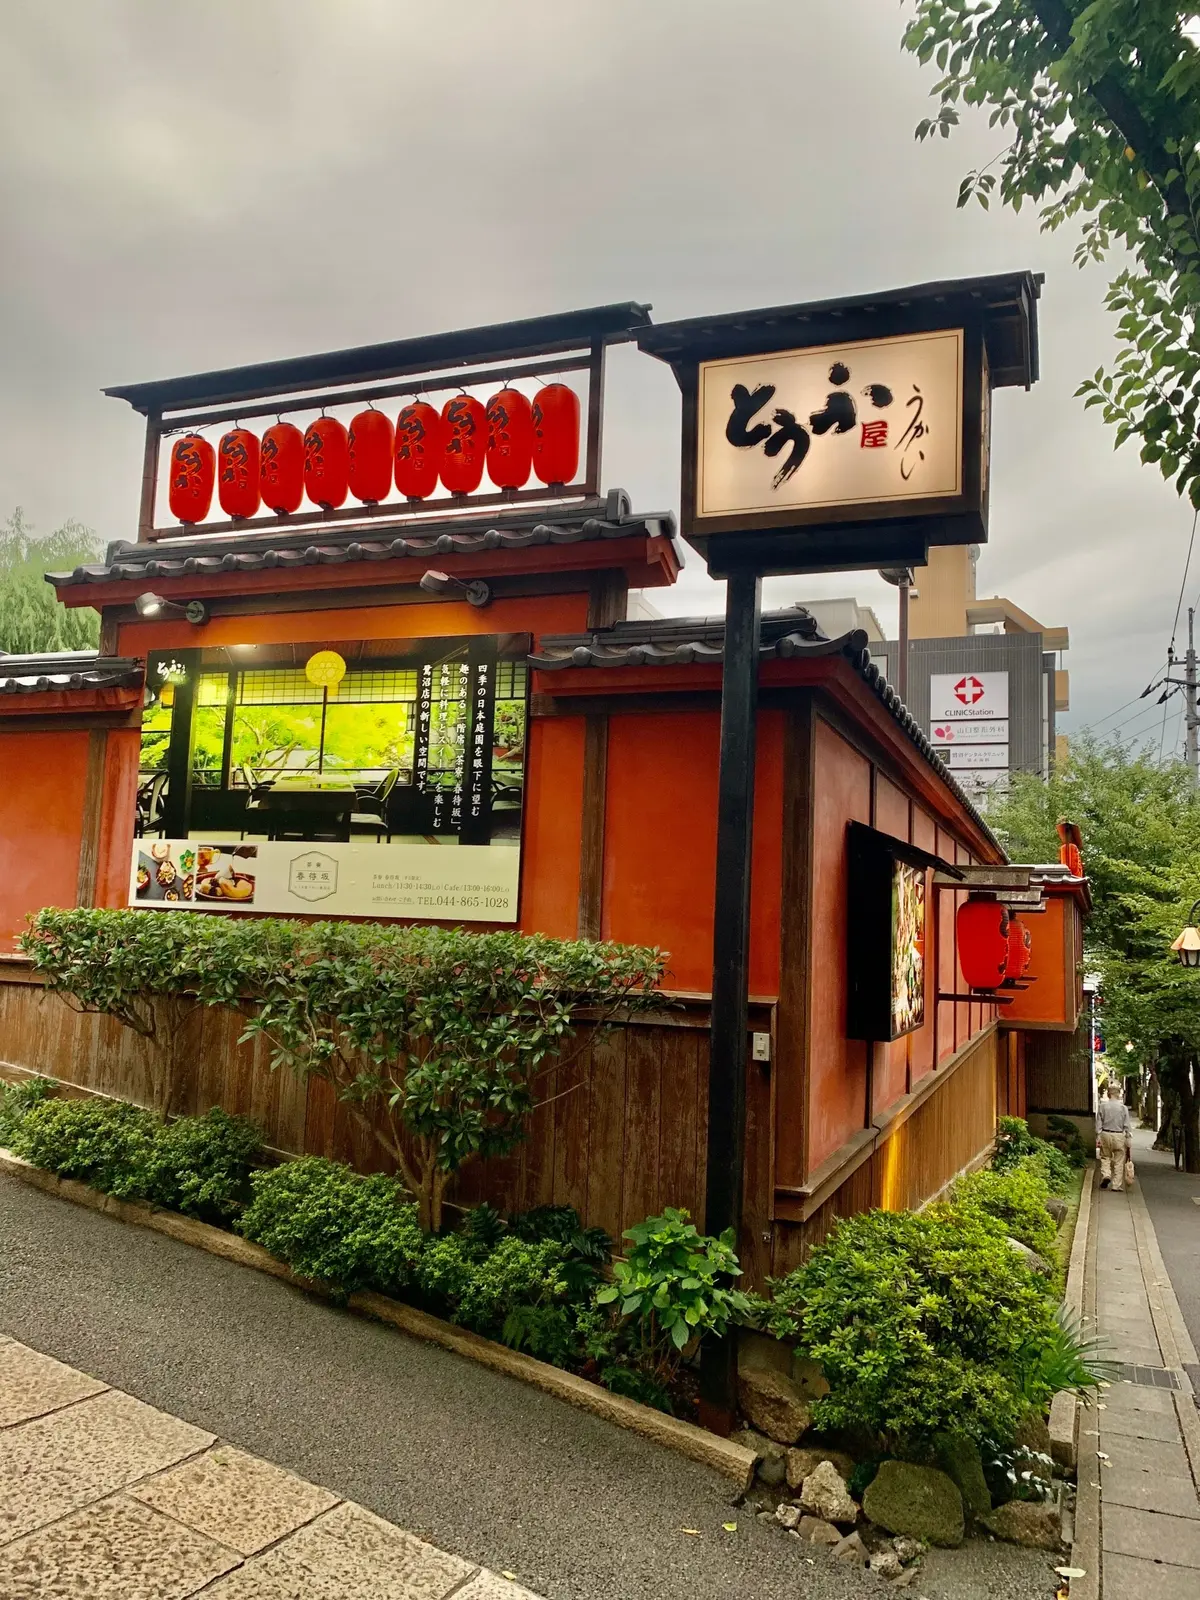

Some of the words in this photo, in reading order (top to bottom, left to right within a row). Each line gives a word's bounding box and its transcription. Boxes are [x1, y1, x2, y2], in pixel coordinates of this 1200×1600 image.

[726, 361, 893, 491] とうふ
[860, 420, 888, 448] 屋
[895, 384, 929, 480] うかい
[416, 664, 432, 794] 鷺沼店の新しい空間です。
[433, 664, 450, 827] 気軽に料理とスイーツを楽しむ
[471, 664, 488, 816] 四季の日本庭園を眼下に望む
